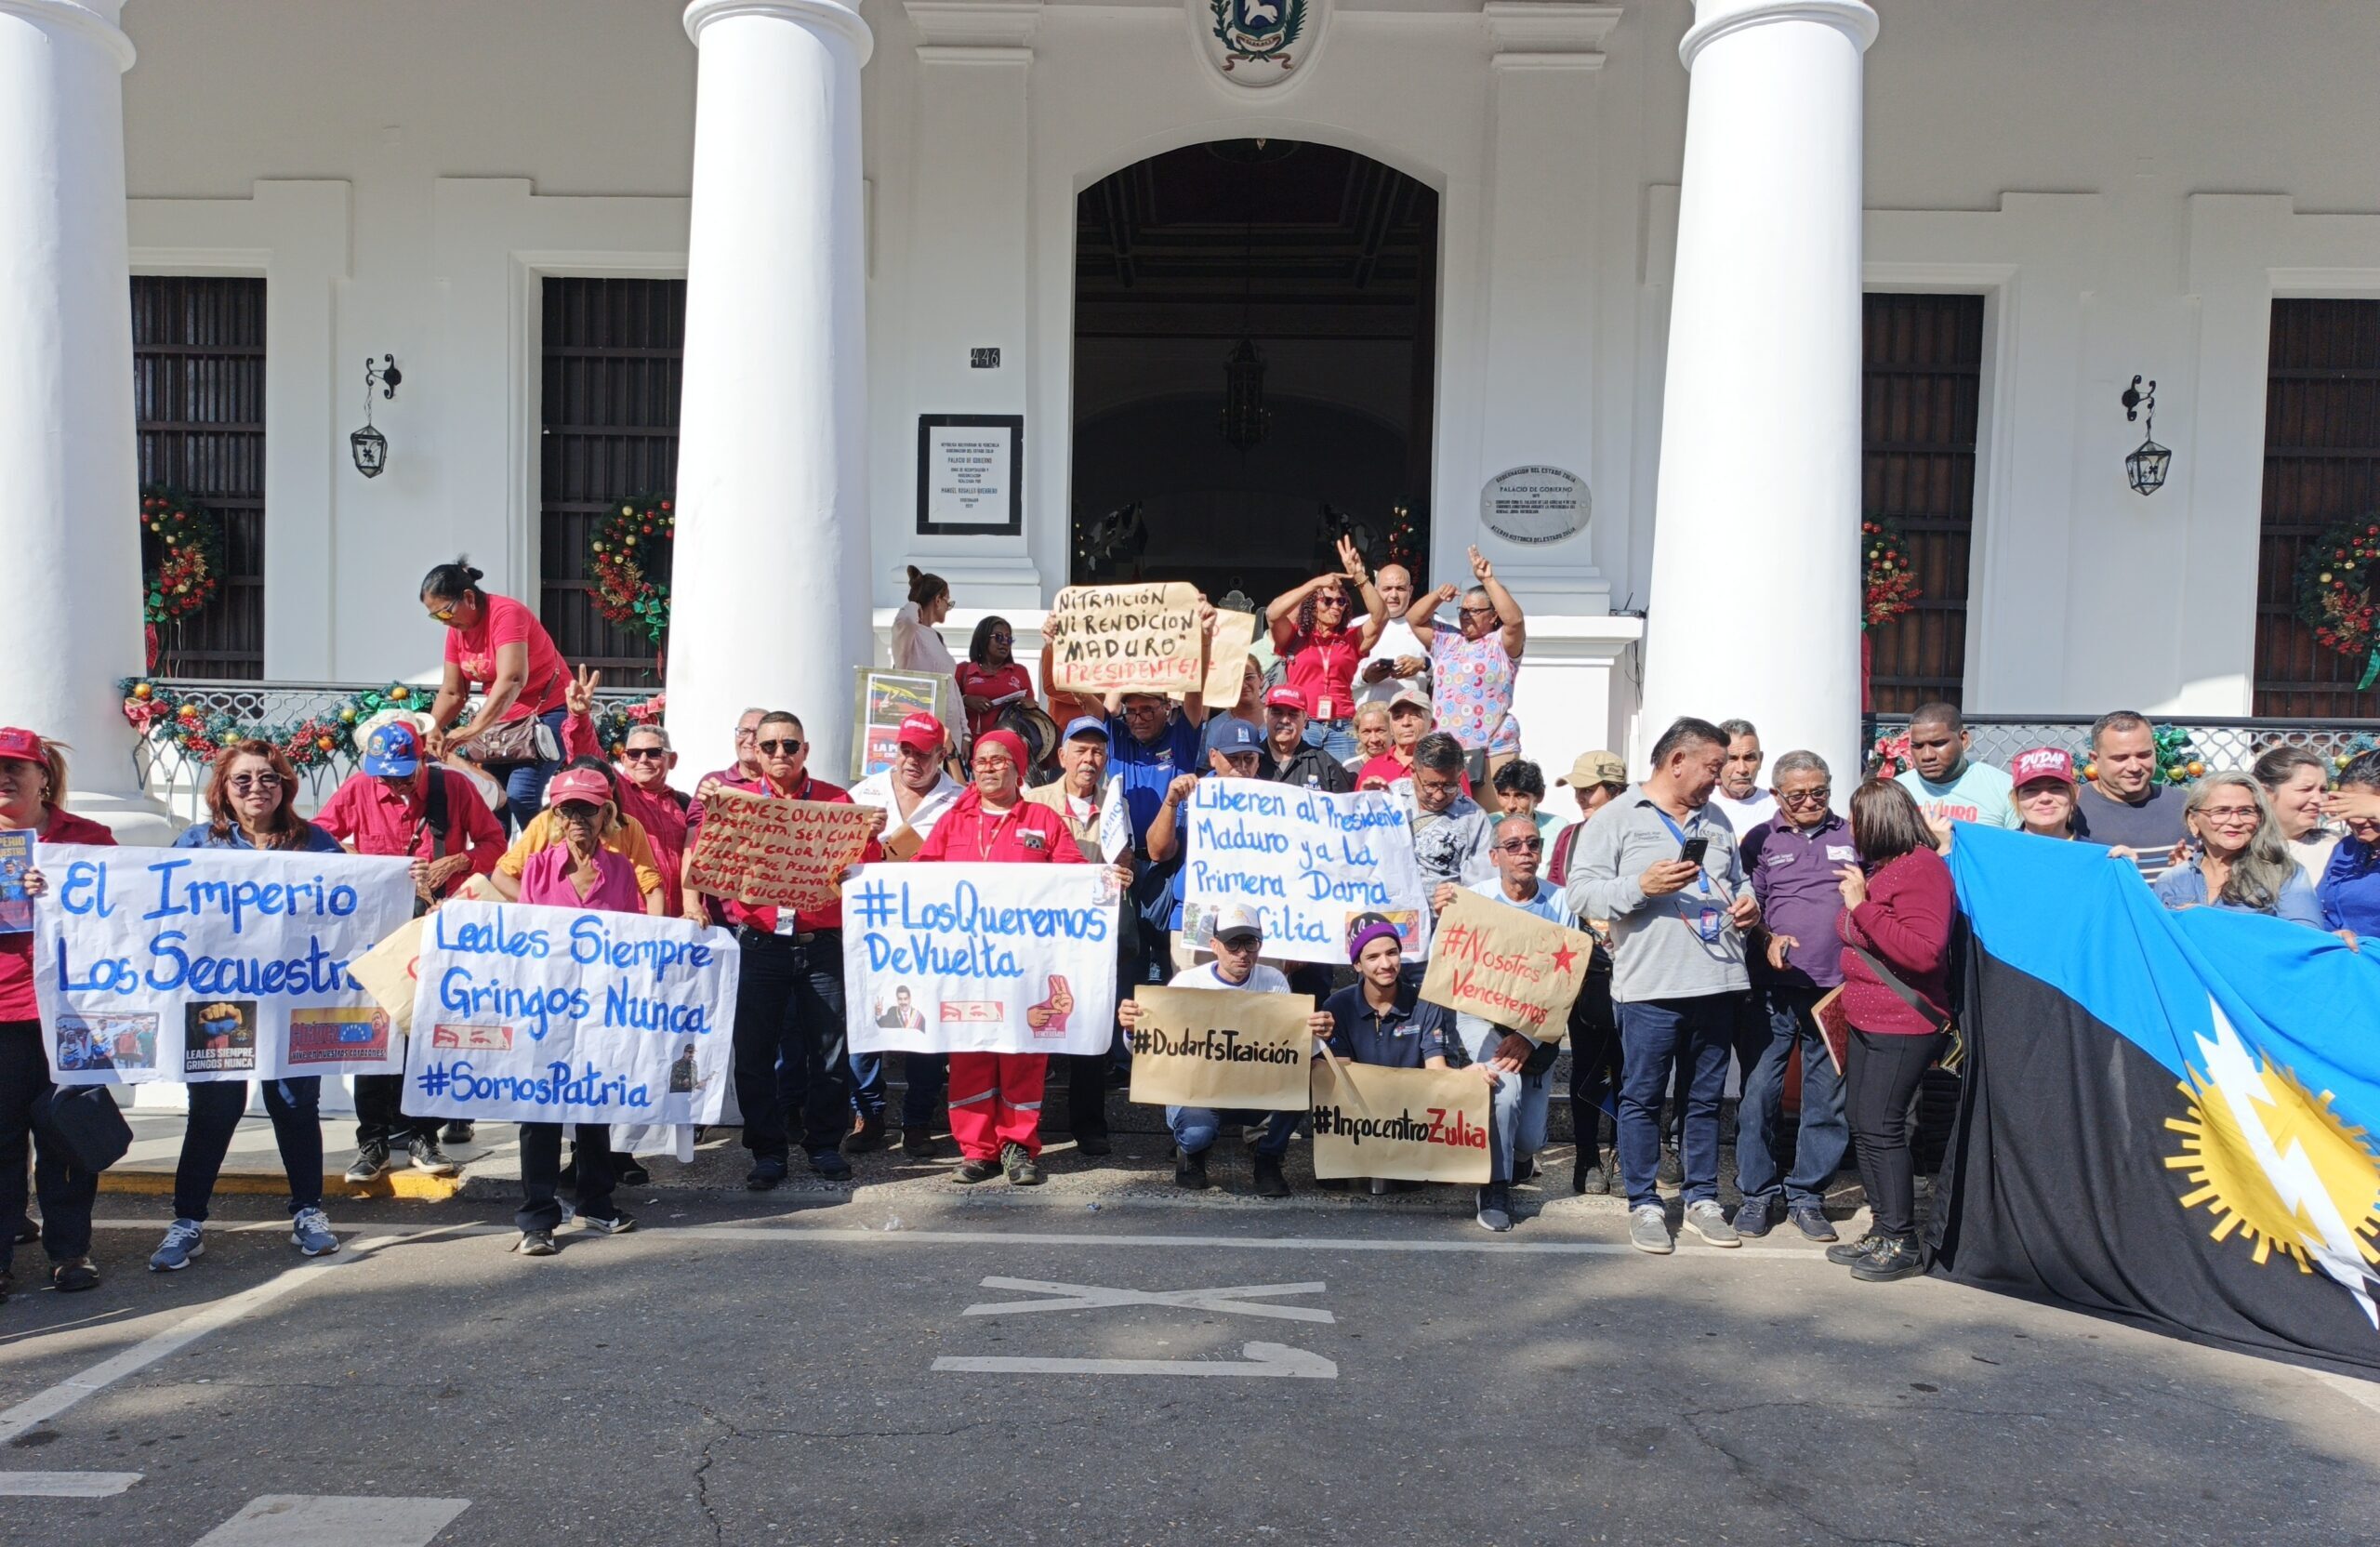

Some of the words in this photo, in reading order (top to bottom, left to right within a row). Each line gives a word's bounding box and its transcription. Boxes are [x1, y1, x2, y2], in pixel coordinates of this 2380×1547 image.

[972, 349, 998, 365] 446
[1196, 781, 1286, 817] Liberen
[1296, 792, 1319, 825] al
[826, 828, 863, 842] CUAL
[1197, 818, 1289, 853] Maduro
[60, 860, 117, 919] El
[142, 858, 358, 933] Imperio
[1192, 860, 1287, 898] Primera
[1299, 870, 1392, 906] Dama
[853, 879, 1107, 942] #LosQueremos
[1258, 904, 1332, 944] Cilia
[58, 936, 139, 995] Los
[437, 906, 549, 959] Leales
[569, 915, 714, 982] Siempre
[440, 966, 590, 1040] Gringos
[604, 977, 712, 1035] Nunca
[186, 1049, 216, 1060] LEALES
[187, 1058, 222, 1070] GRINGOS
[223, 1058, 253, 1068] NUNCA
[1133, 1027, 1299, 1065] #DudarEsTraición
[417, 1060, 652, 1108] #SomosPatria
